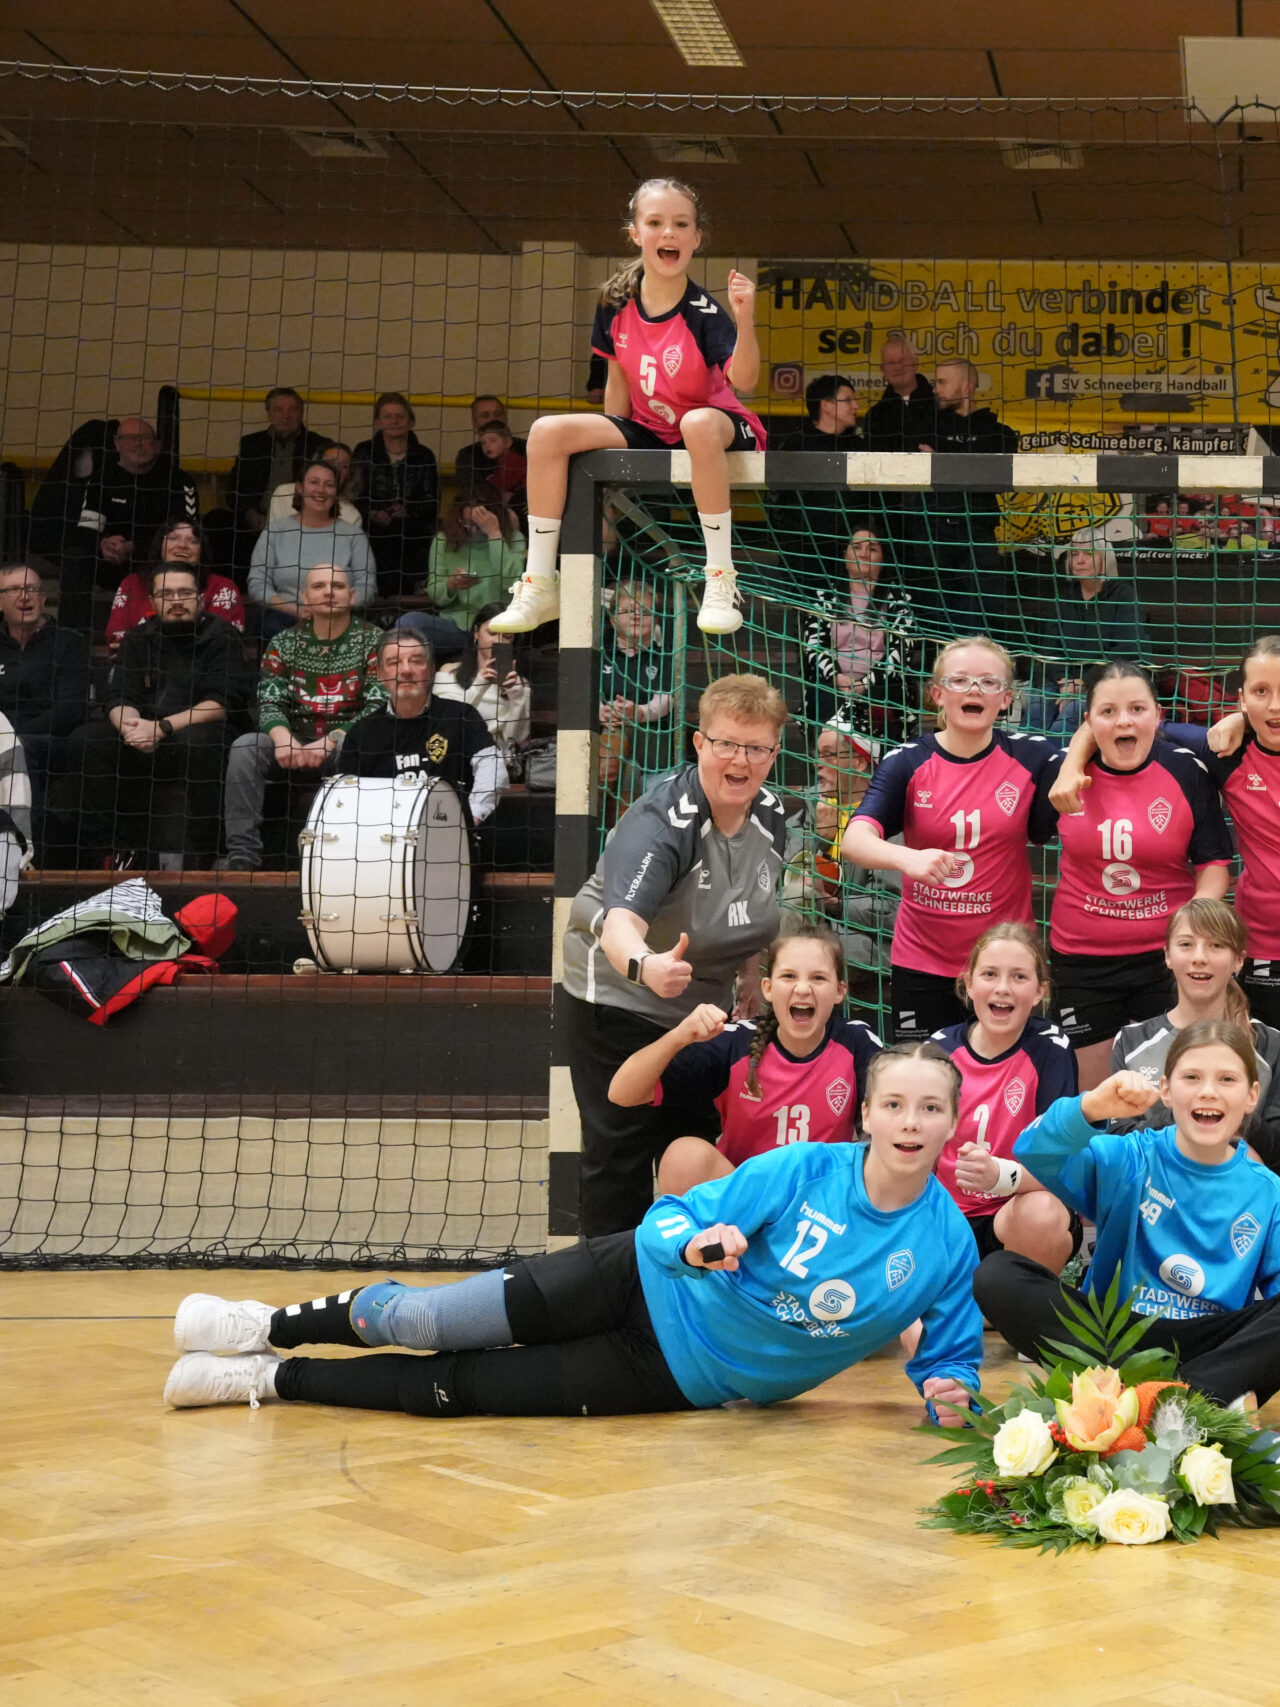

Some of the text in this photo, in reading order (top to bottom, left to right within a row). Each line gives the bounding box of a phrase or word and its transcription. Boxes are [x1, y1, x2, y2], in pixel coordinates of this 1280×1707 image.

[774, 277, 1005, 312] HANDBALL
[1016, 279, 1211, 315] verbindet
[817, 321, 873, 354] sei
[992, 322, 1042, 357] du
[1055, 322, 1168, 358] dabei
[1182, 323, 1191, 358] !
[639, 355, 657, 397] 5
[1062, 378, 1226, 392] SV Schneeberg Handball
[1070, 434, 1167, 452] Schneeberg,
[949, 809, 981, 849] 11
[1097, 818, 1133, 860] 16
[624, 852, 654, 902] FLYERALARM
[913, 881, 993, 902] STADTWERKE
[728, 900, 751, 927] RK
[913, 892, 992, 914] SCHNEEBERG
[1085, 890, 1167, 909] STADTWERKE
[773, 1104, 811, 1146] 13
[799, 1201, 847, 1236] hummel
[1139, 1199, 1163, 1226] 49
[779, 1219, 829, 1280] 12
